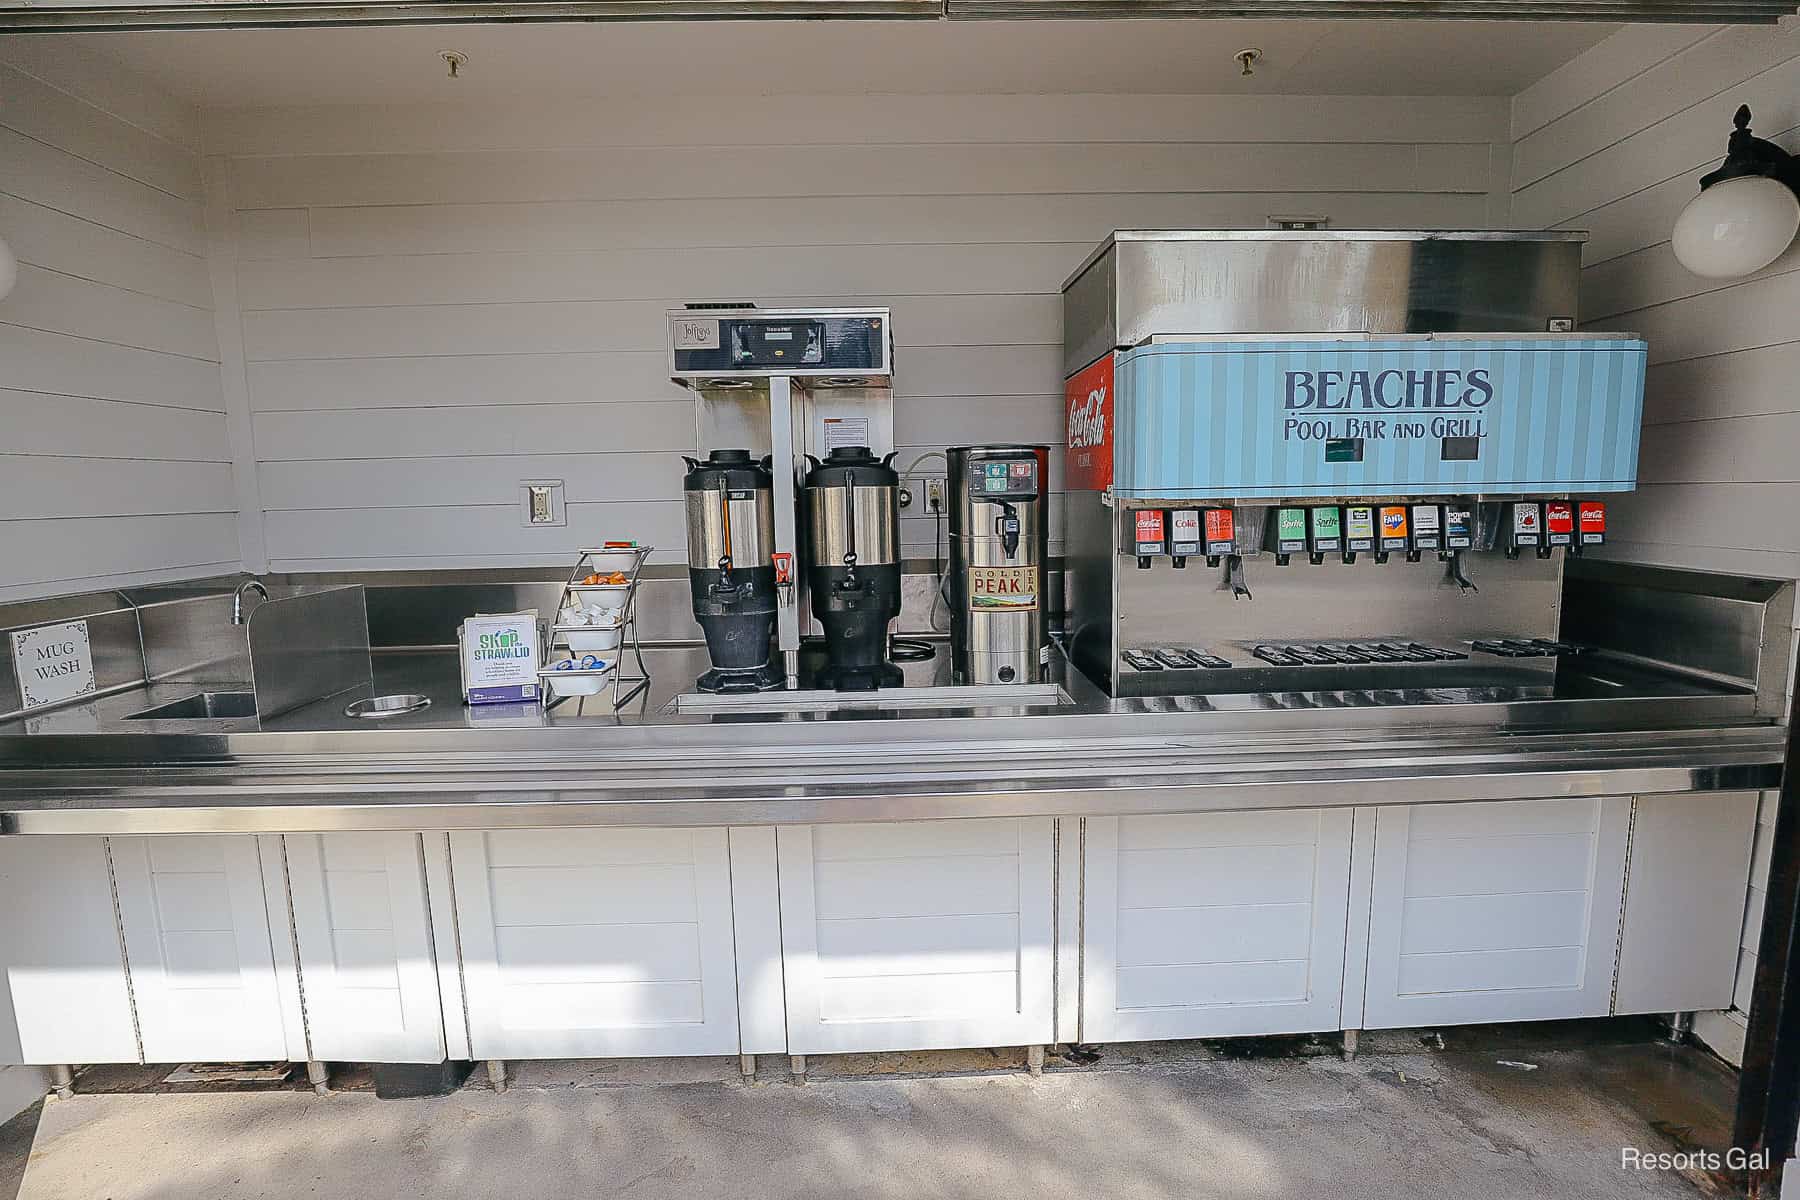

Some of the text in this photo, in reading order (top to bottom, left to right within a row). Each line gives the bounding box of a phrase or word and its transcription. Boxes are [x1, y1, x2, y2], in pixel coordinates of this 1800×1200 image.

[1284, 369, 1494, 409] BEACHES
[1175, 519, 1197, 528] Coke
[1282, 519, 1303, 529] Sprite
[1316, 517, 1337, 529] Sprite
[974, 578, 1021, 593] PEAK
[36, 641, 74, 661] MUG
[474, 646, 530, 661] STRAW LID
[34, 659, 81, 680] WASH
